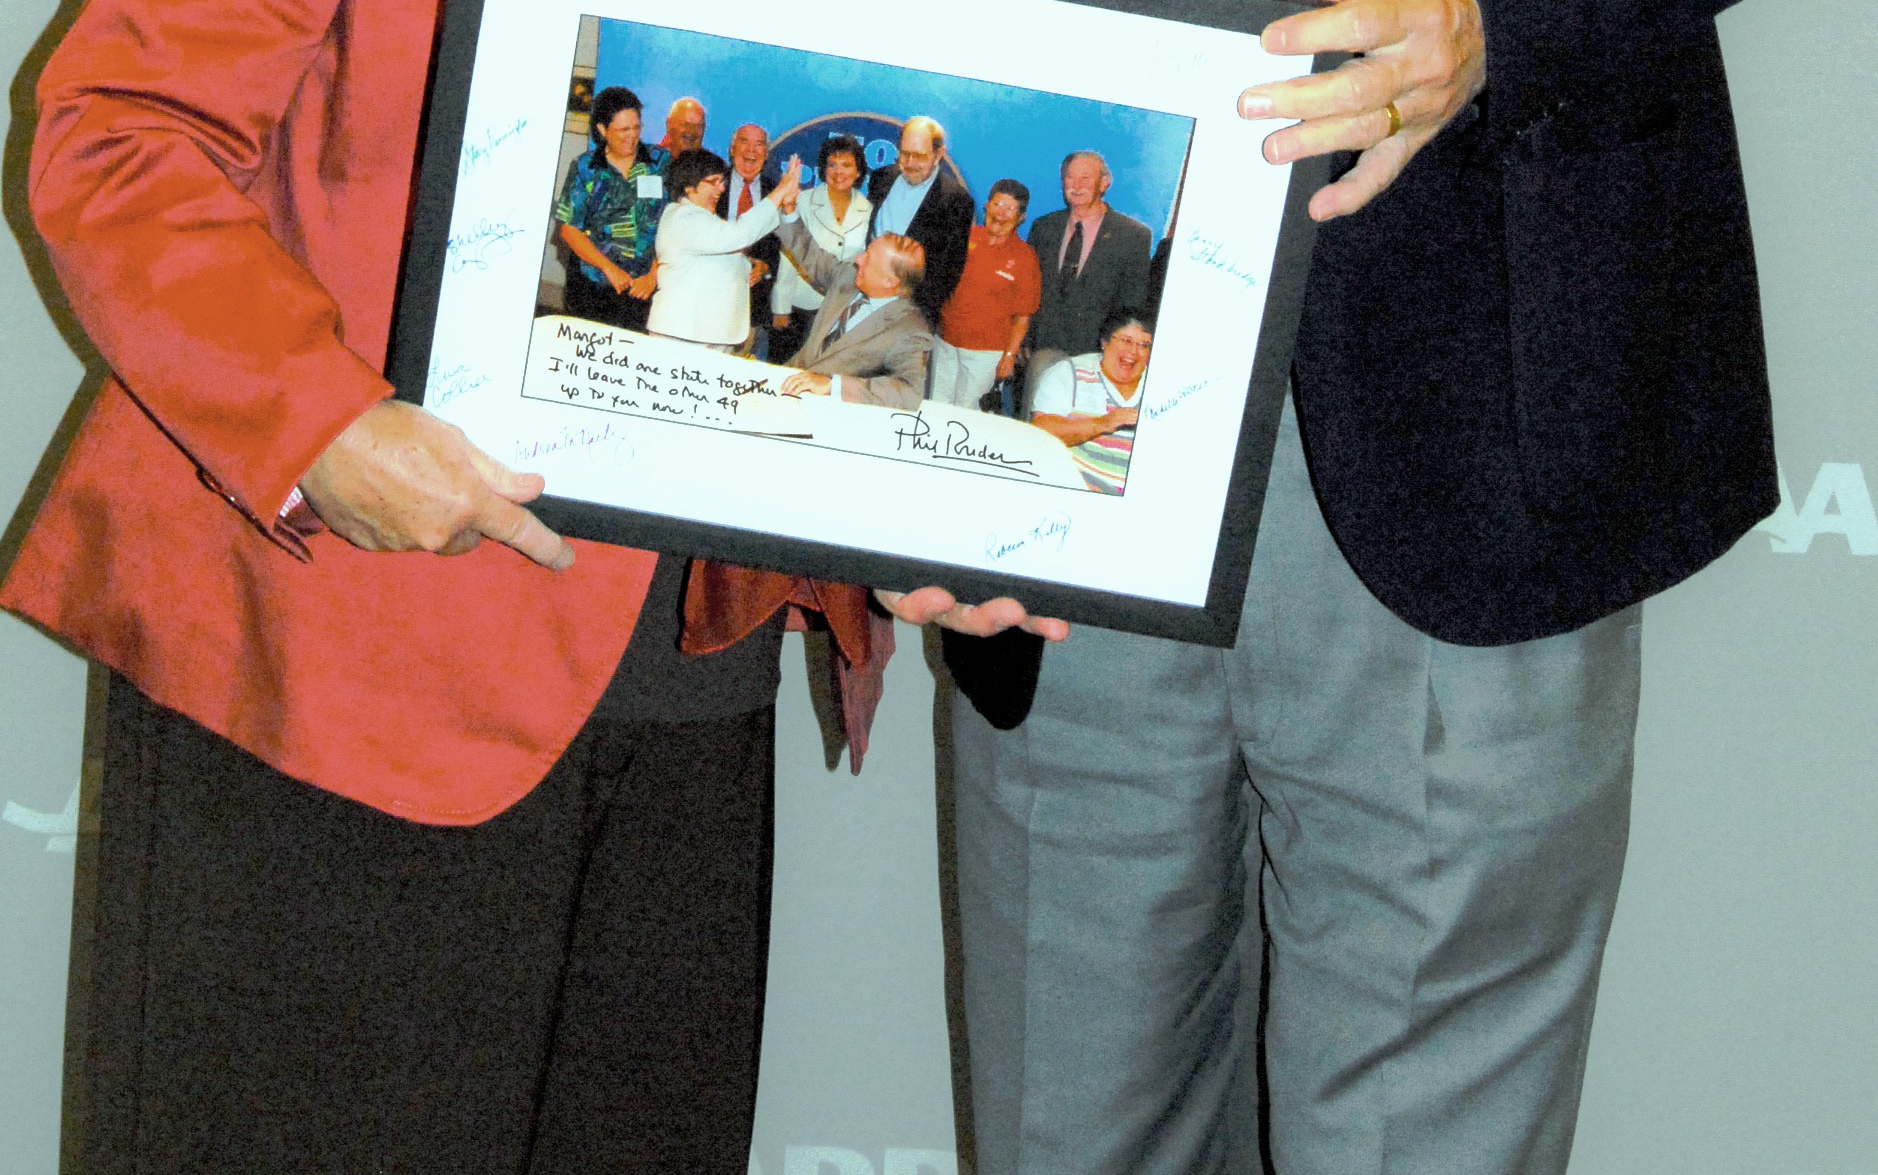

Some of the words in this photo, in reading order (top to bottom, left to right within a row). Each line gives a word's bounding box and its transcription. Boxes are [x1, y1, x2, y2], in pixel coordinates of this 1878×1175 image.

[576, 345, 597, 361] We
[603, 352, 629, 368] did
[548, 356, 578, 375] I'll
[588, 366, 626, 387] leave
[717, 397, 738, 415] 49
[560, 384, 580, 400] up
[612, 394, 639, 408] you
